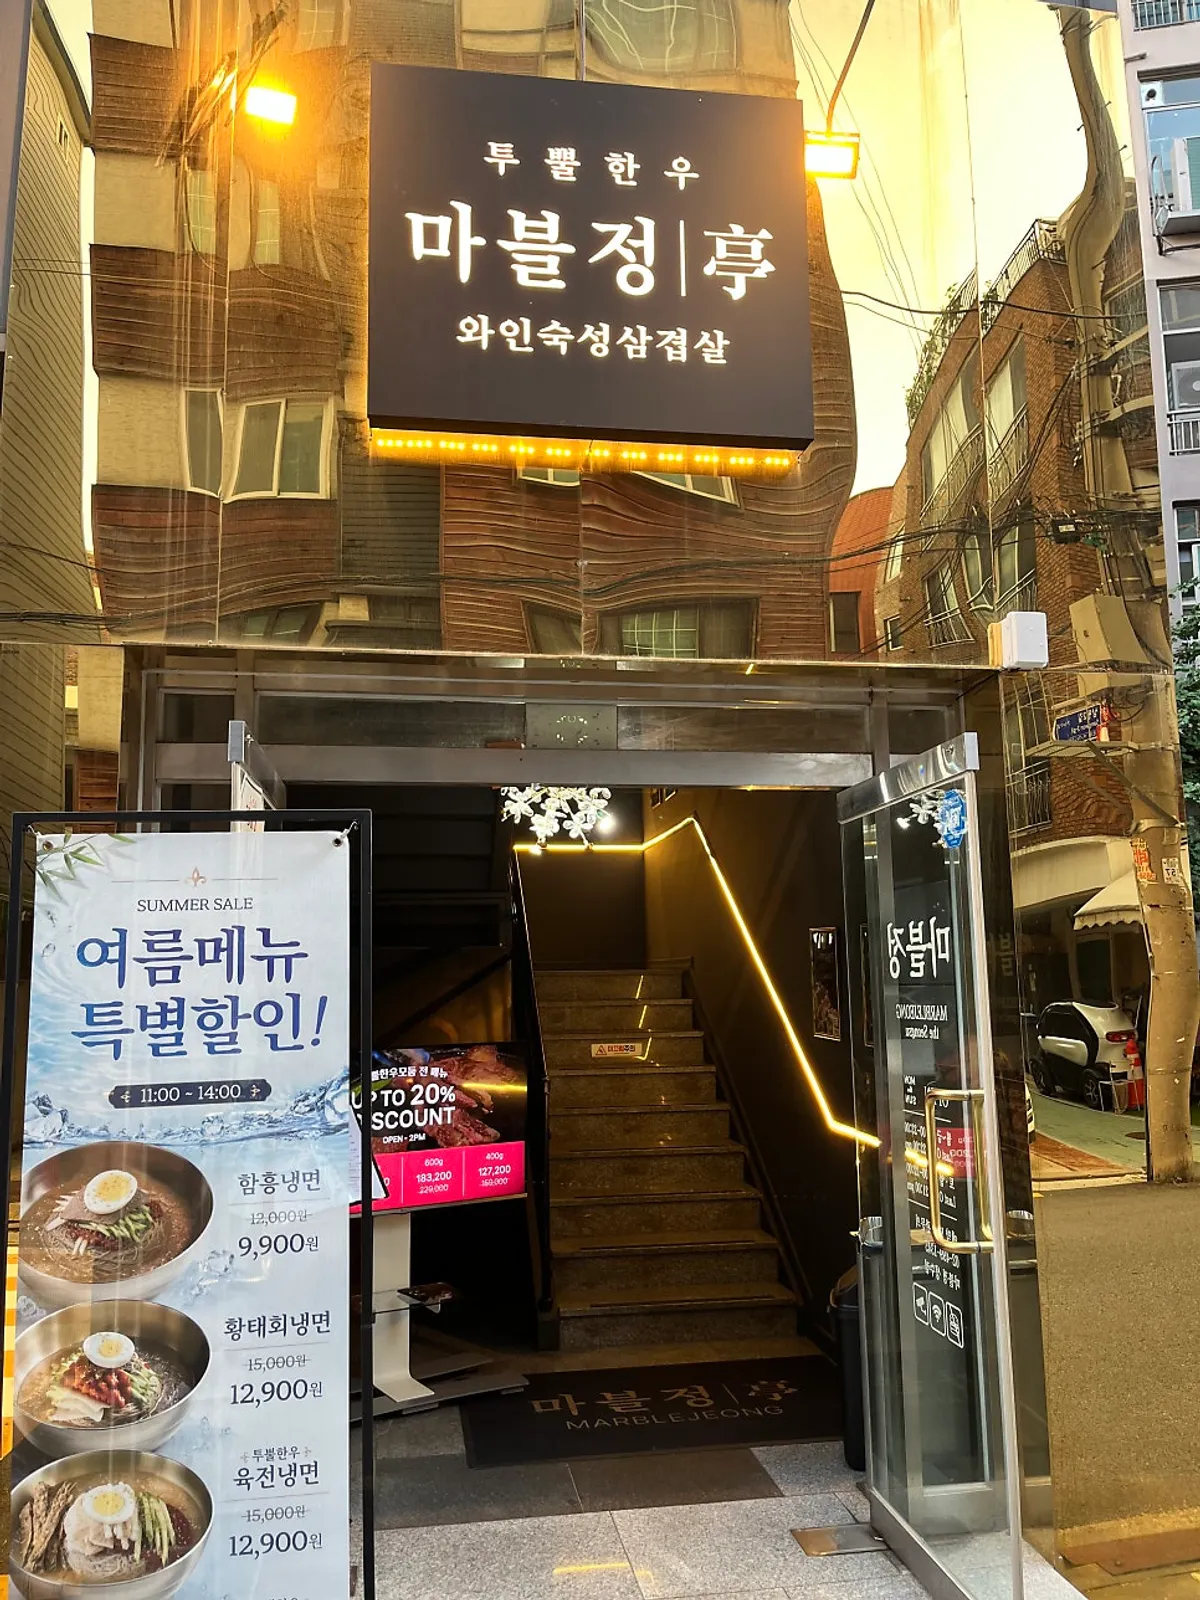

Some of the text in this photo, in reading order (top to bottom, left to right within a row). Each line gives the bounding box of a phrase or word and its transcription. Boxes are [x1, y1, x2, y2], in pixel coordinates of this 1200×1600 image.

[404, 200, 776, 300] 마블정 亭
[137, 897, 254, 912] SUMMER SALE
[76, 925, 308, 989] 여름메뉴
[71, 992, 328, 1061] 특별할인!
[140, 1087, 181, 1103] 11:00
[197, 1084, 242, 1100] 14:00
[380, 1089, 406, 1107] TO
[410, 1083, 456, 1106] 20%
[382, 1135, 404, 1144] OPEN
[408, 1133, 426, 1142] 2PM
[238, 1168, 321, 1196] 함흥냉면
[478, 1164, 511, 1177] 127,200
[238, 1233, 319, 1260] 9,900원
[223, 1310, 331, 1341] 황태회냉면
[230, 1378, 323, 1408] 12,900원
[566, 1403, 784, 1430] MARBLEJEONG
[233, 1460, 320, 1491] 육전냉면
[228, 1530, 323, 1560] 12,900원
